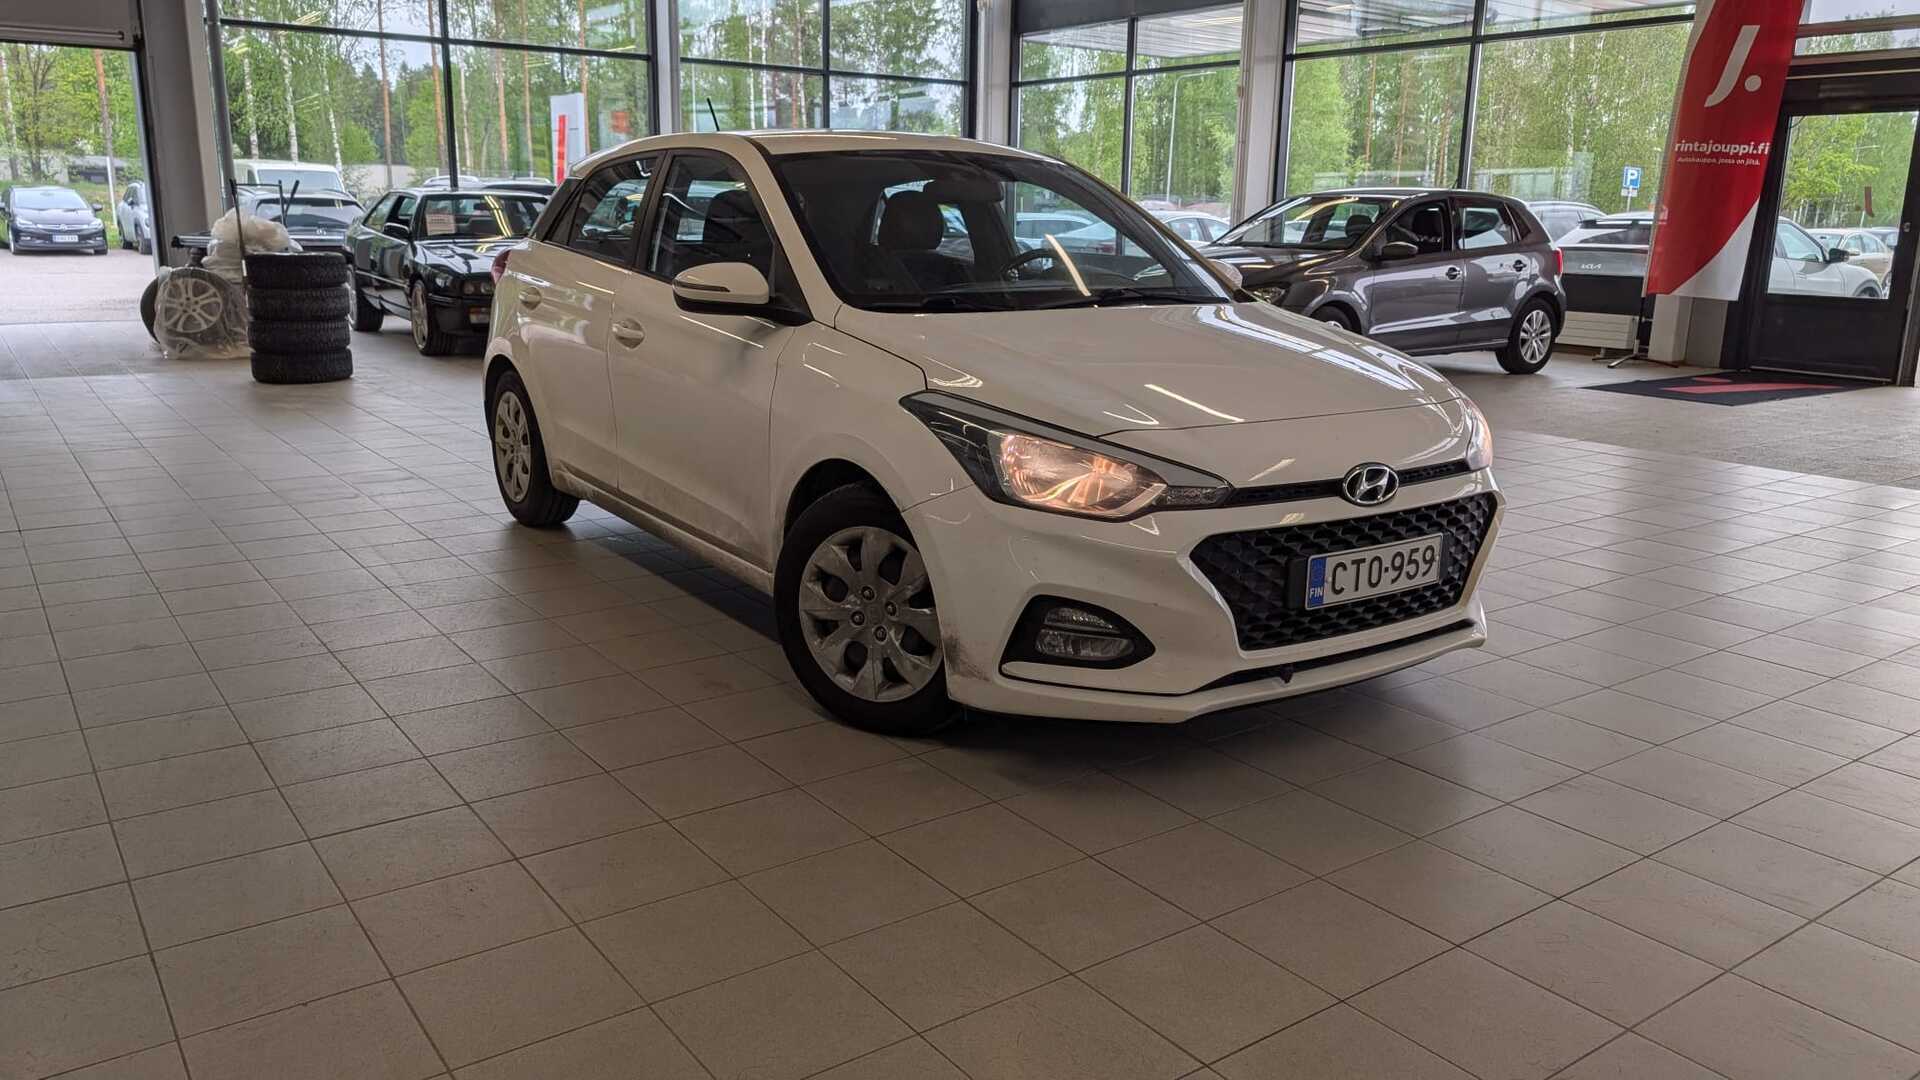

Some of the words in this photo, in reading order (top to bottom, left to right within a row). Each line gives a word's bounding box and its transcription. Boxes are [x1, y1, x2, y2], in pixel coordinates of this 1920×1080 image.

[1674, 140, 1770, 155] rintajouppi.fi
[1627, 169, 1638, 188] P
[1331, 545, 1435, 595] CTO-959
[1309, 587, 1323, 598] FIN
